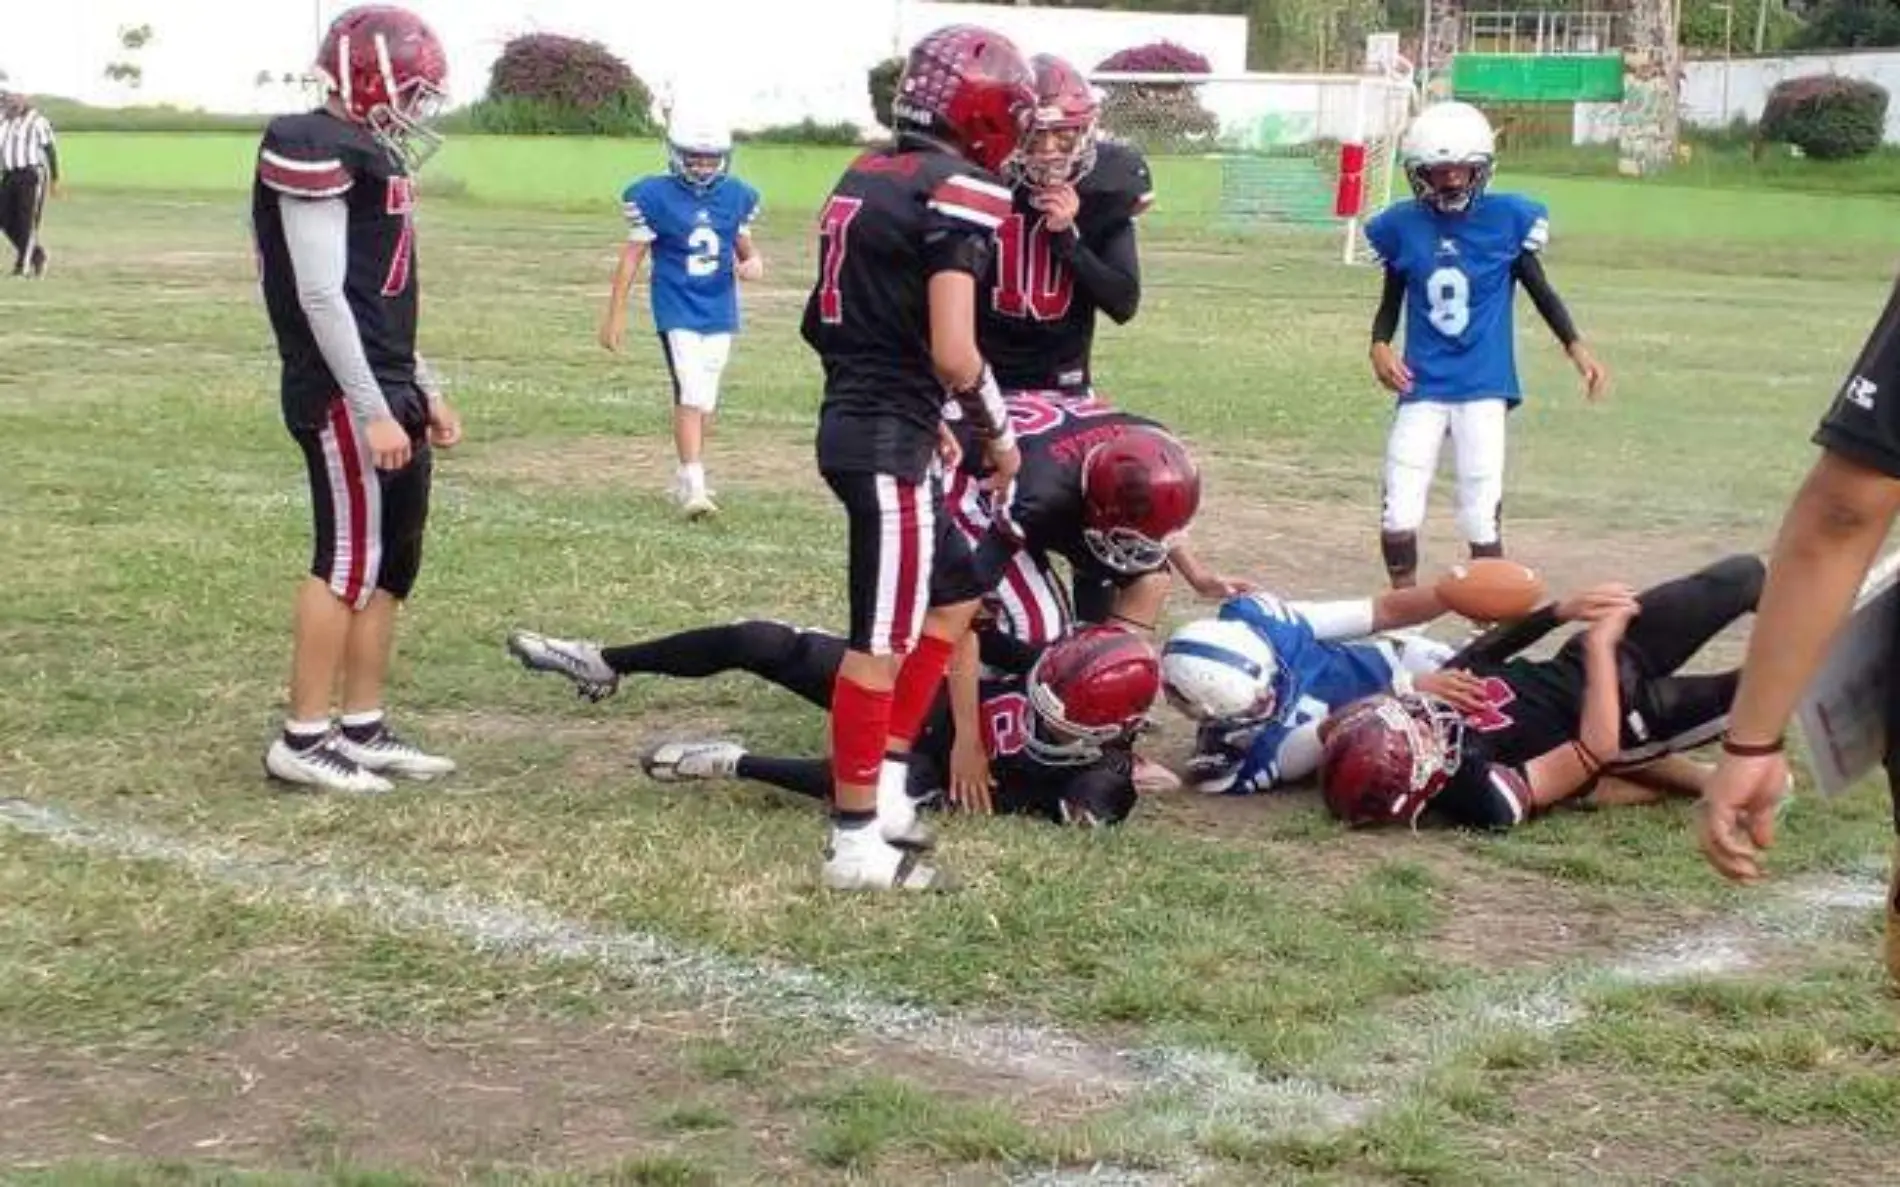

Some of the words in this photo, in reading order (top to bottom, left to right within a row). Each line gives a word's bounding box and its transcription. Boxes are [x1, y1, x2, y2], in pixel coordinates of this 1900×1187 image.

[687, 227, 720, 277] 2
[818, 195, 864, 324] 7
[991, 212, 1074, 322] 10
[1426, 267, 1471, 337] 8
